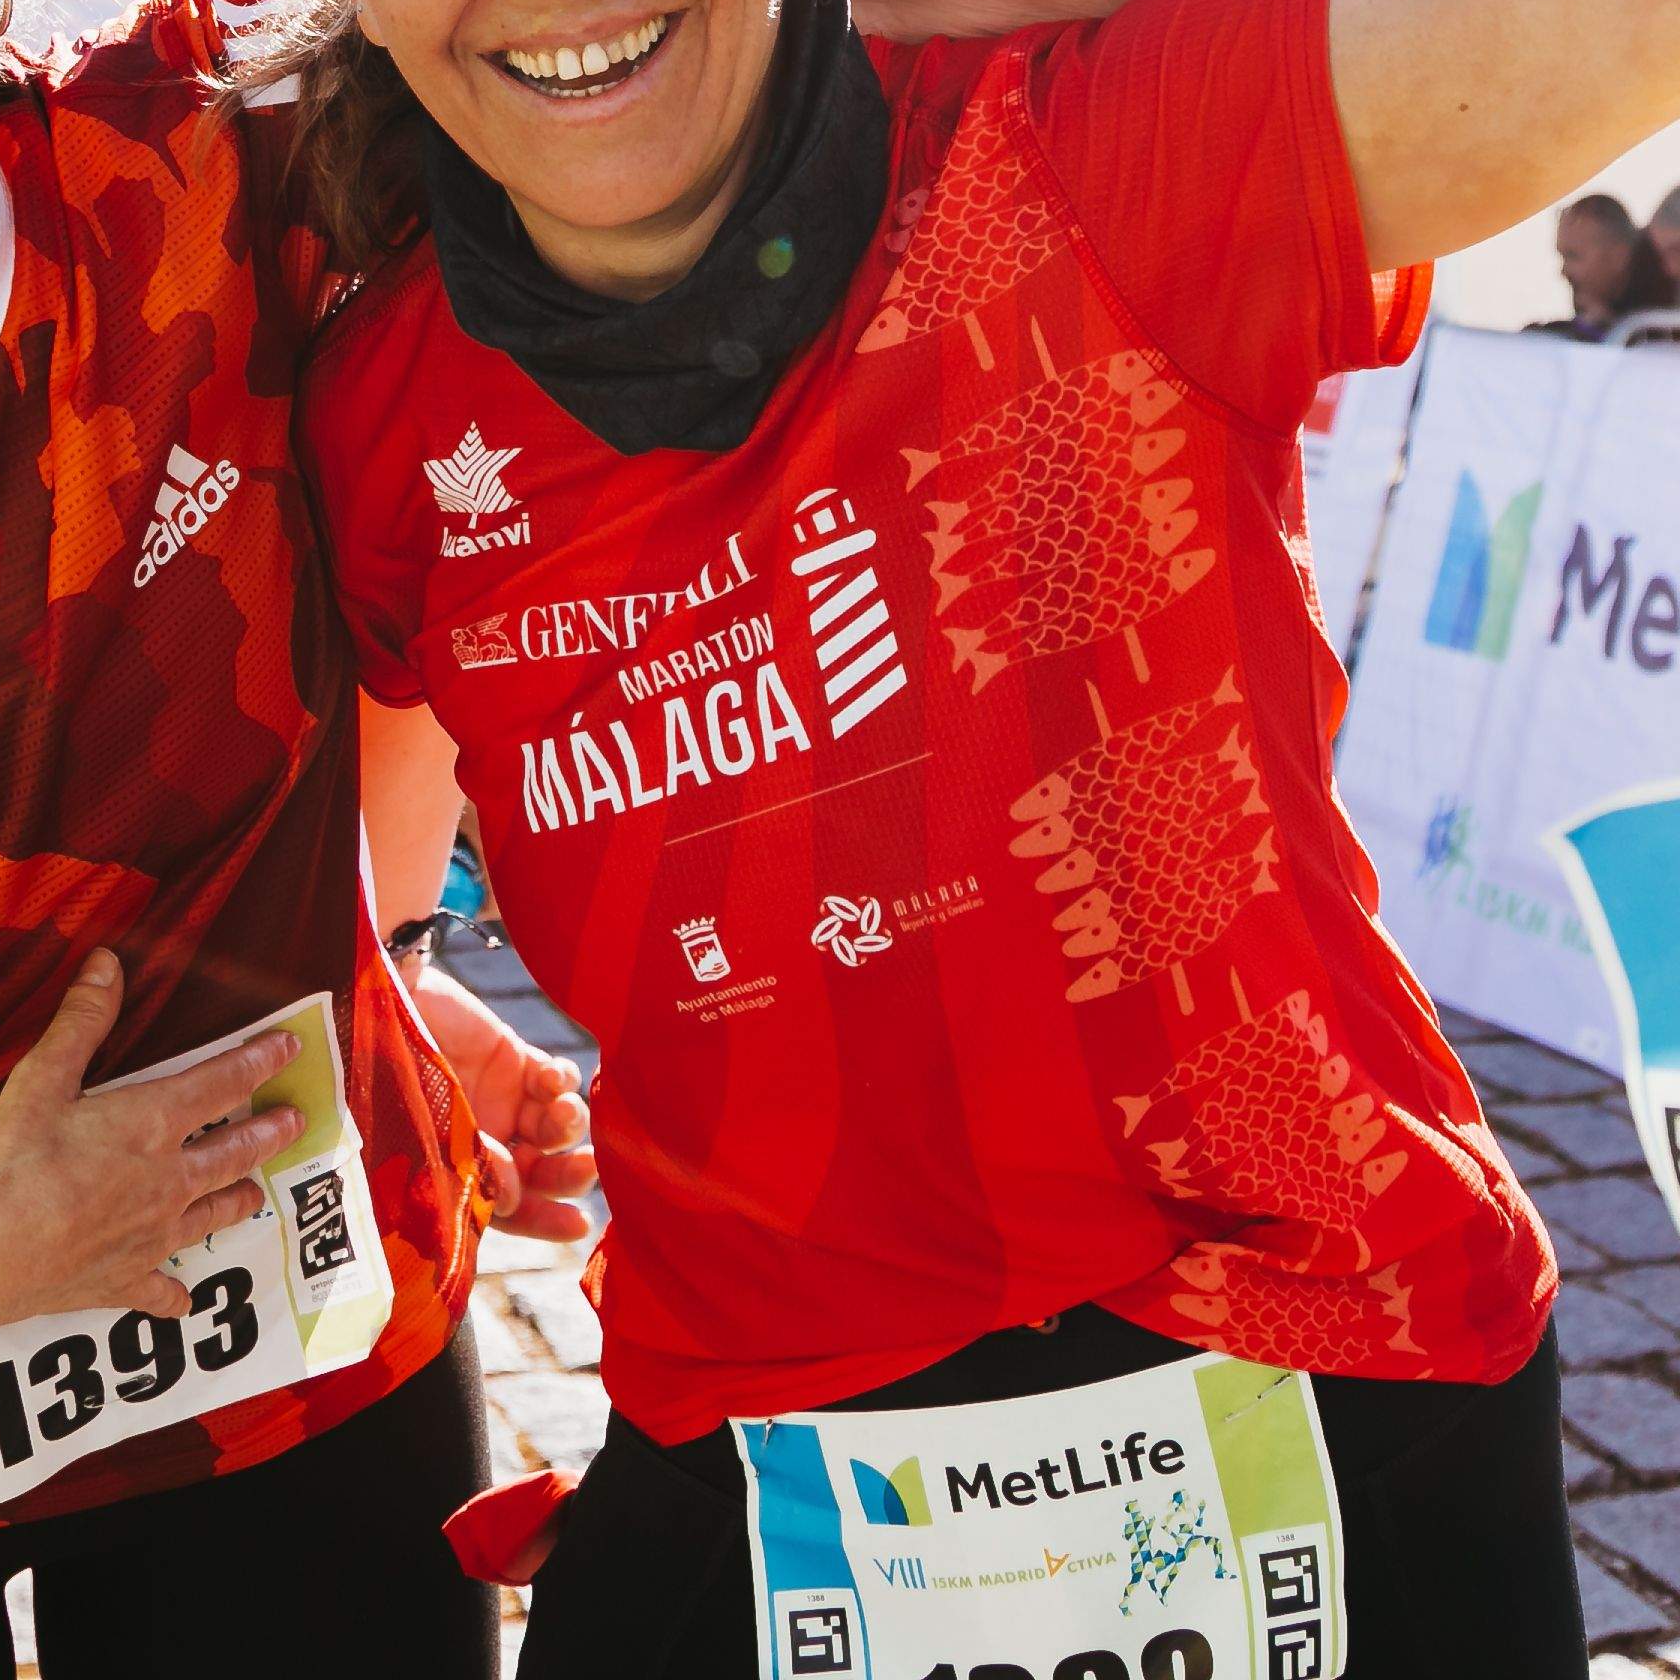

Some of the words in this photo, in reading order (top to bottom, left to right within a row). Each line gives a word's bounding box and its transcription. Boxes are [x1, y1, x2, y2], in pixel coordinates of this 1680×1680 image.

[132, 457, 241, 589] adidas
[617, 612, 776, 705] MARATÓN
[520, 661, 811, 834] MÁLAGA
[676, 975, 778, 1013] Ayuntamiento
[699, 1010, 719, 1023] de
[943, 1430, 1186, 1514] MetLife
[872, 1556, 927, 1589] VIII
[931, 1575, 973, 1590] 15KM
[978, 1567, 1046, 1587] MADRID
